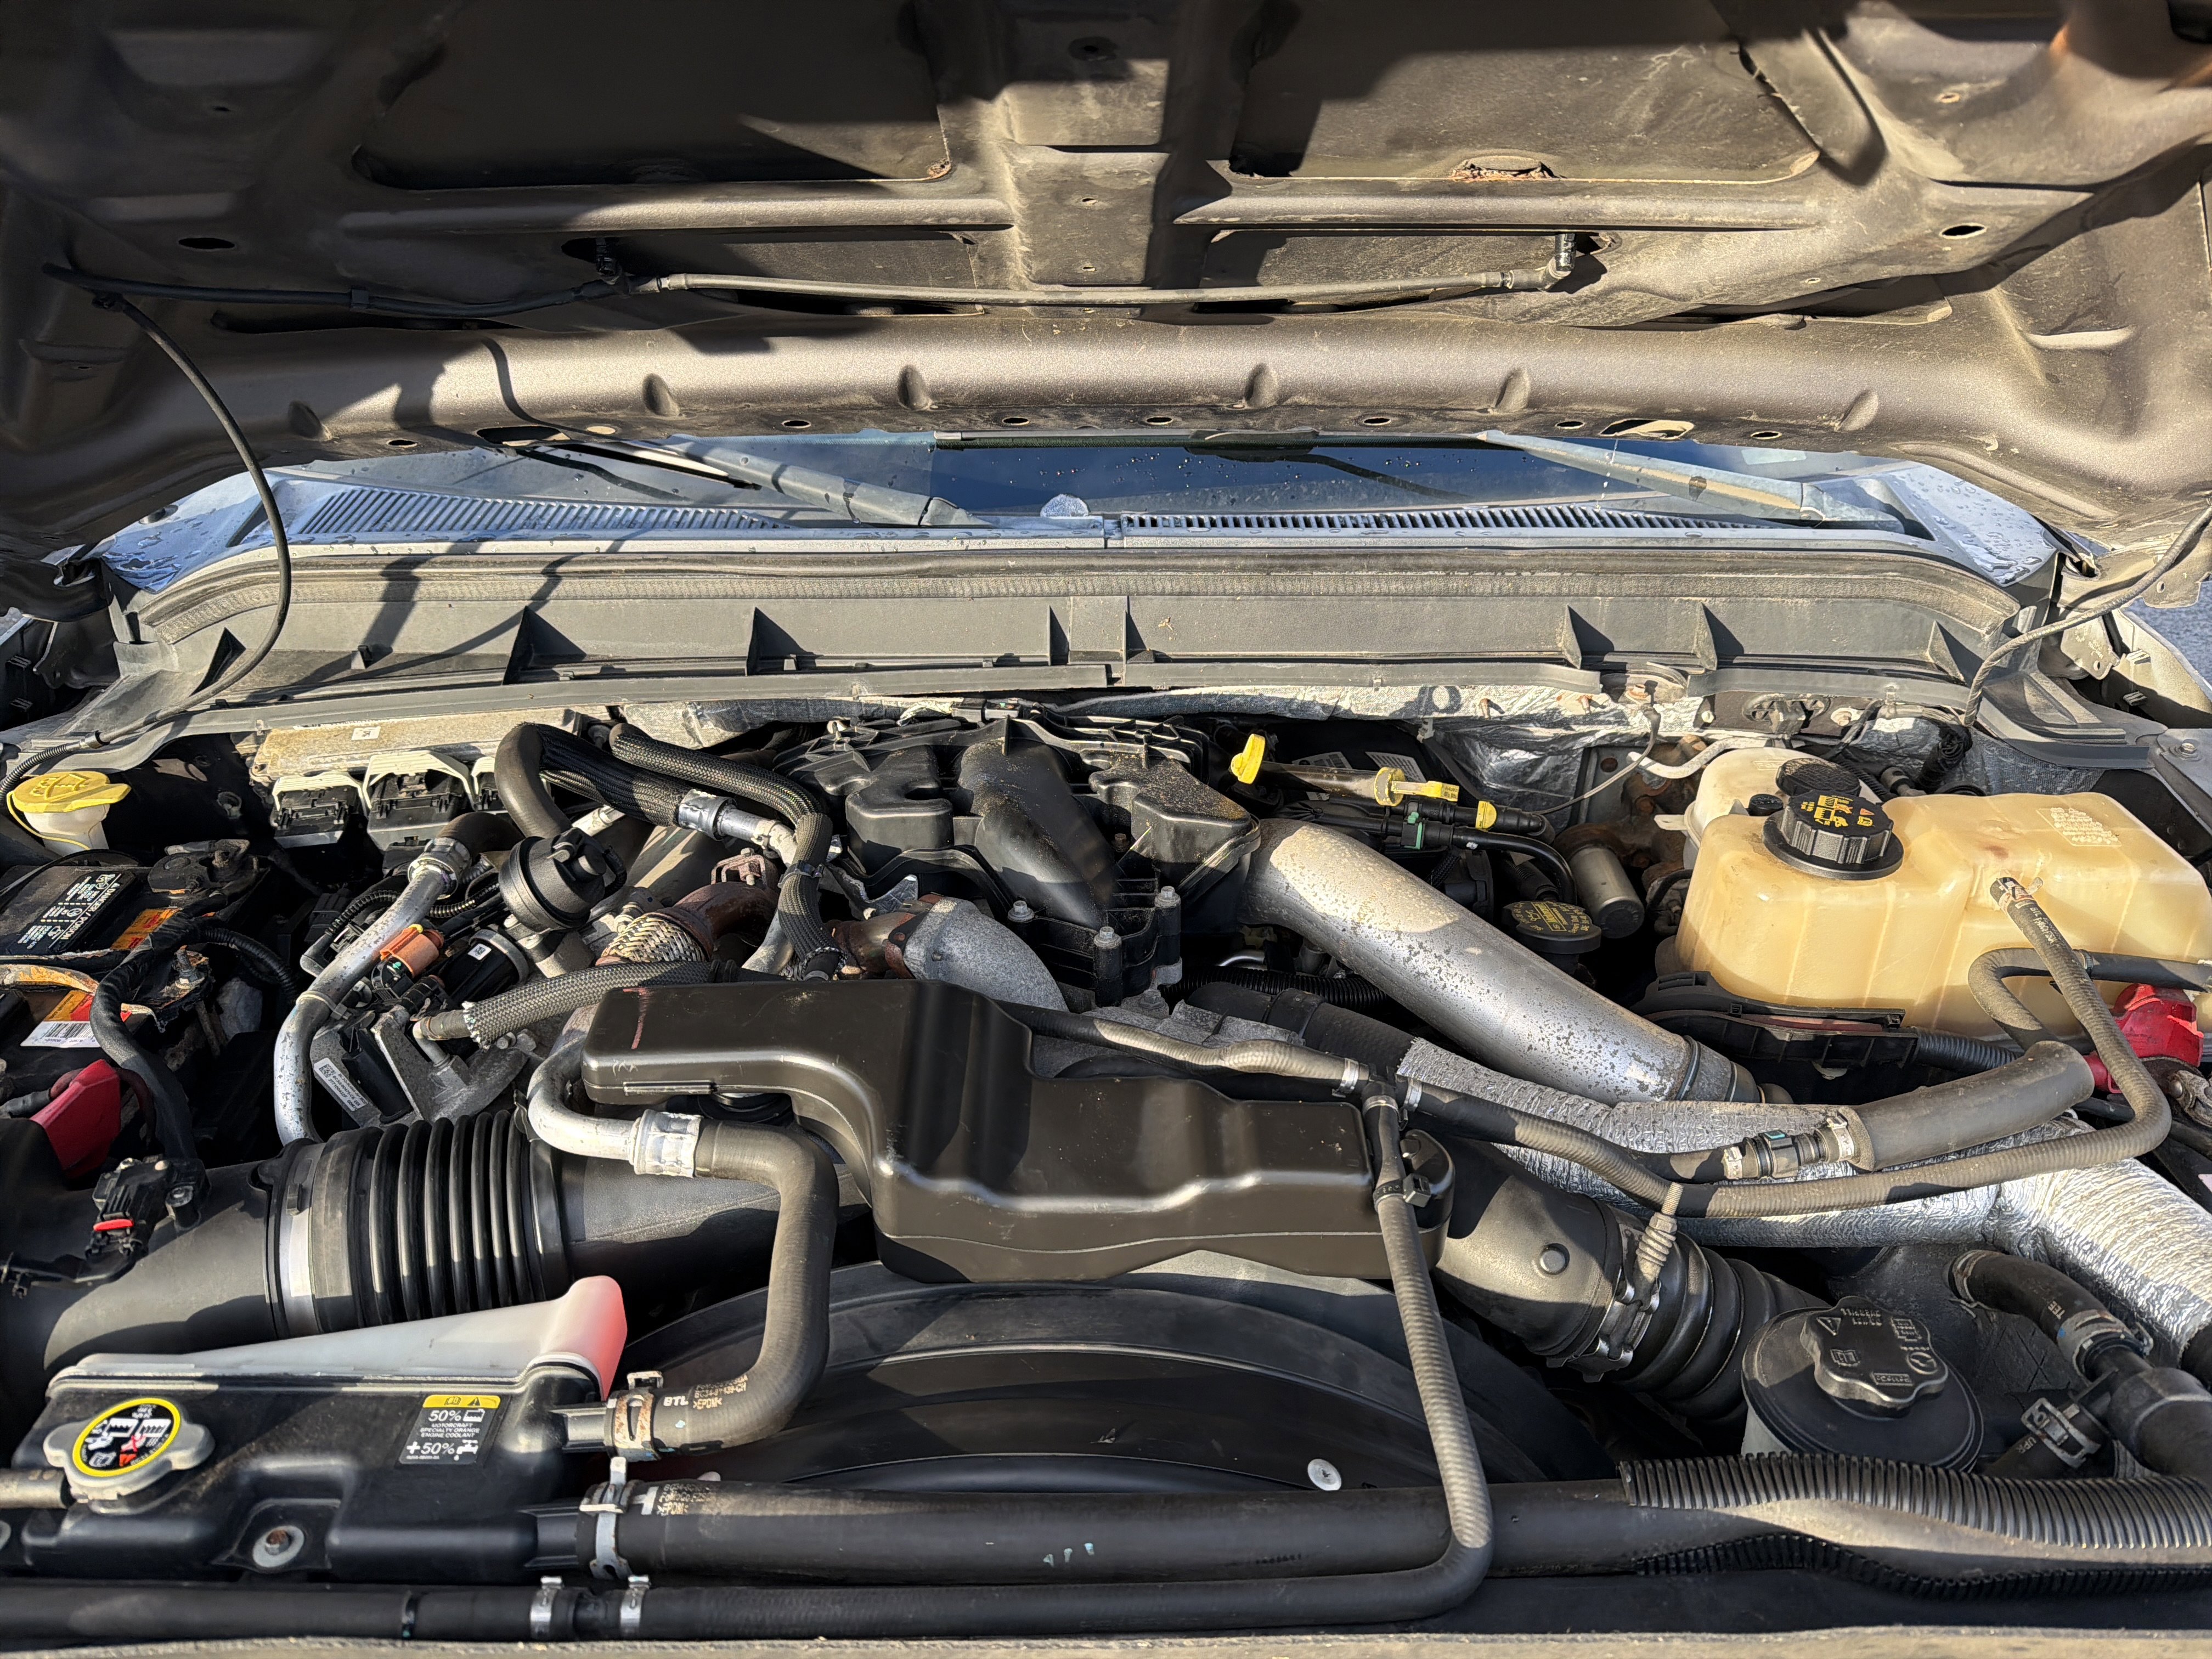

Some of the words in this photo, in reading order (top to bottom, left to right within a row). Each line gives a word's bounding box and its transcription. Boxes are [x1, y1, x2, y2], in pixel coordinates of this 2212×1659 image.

[88, 888, 116, 912] DANGER
[60, 917, 88, 940] POISON
[2047, 1300, 2065, 1319] TEE
[663, 1396, 689, 1406] BTL
[428, 1410, 461, 1421] 50%
[2017, 1436, 2036, 1454] UPR
